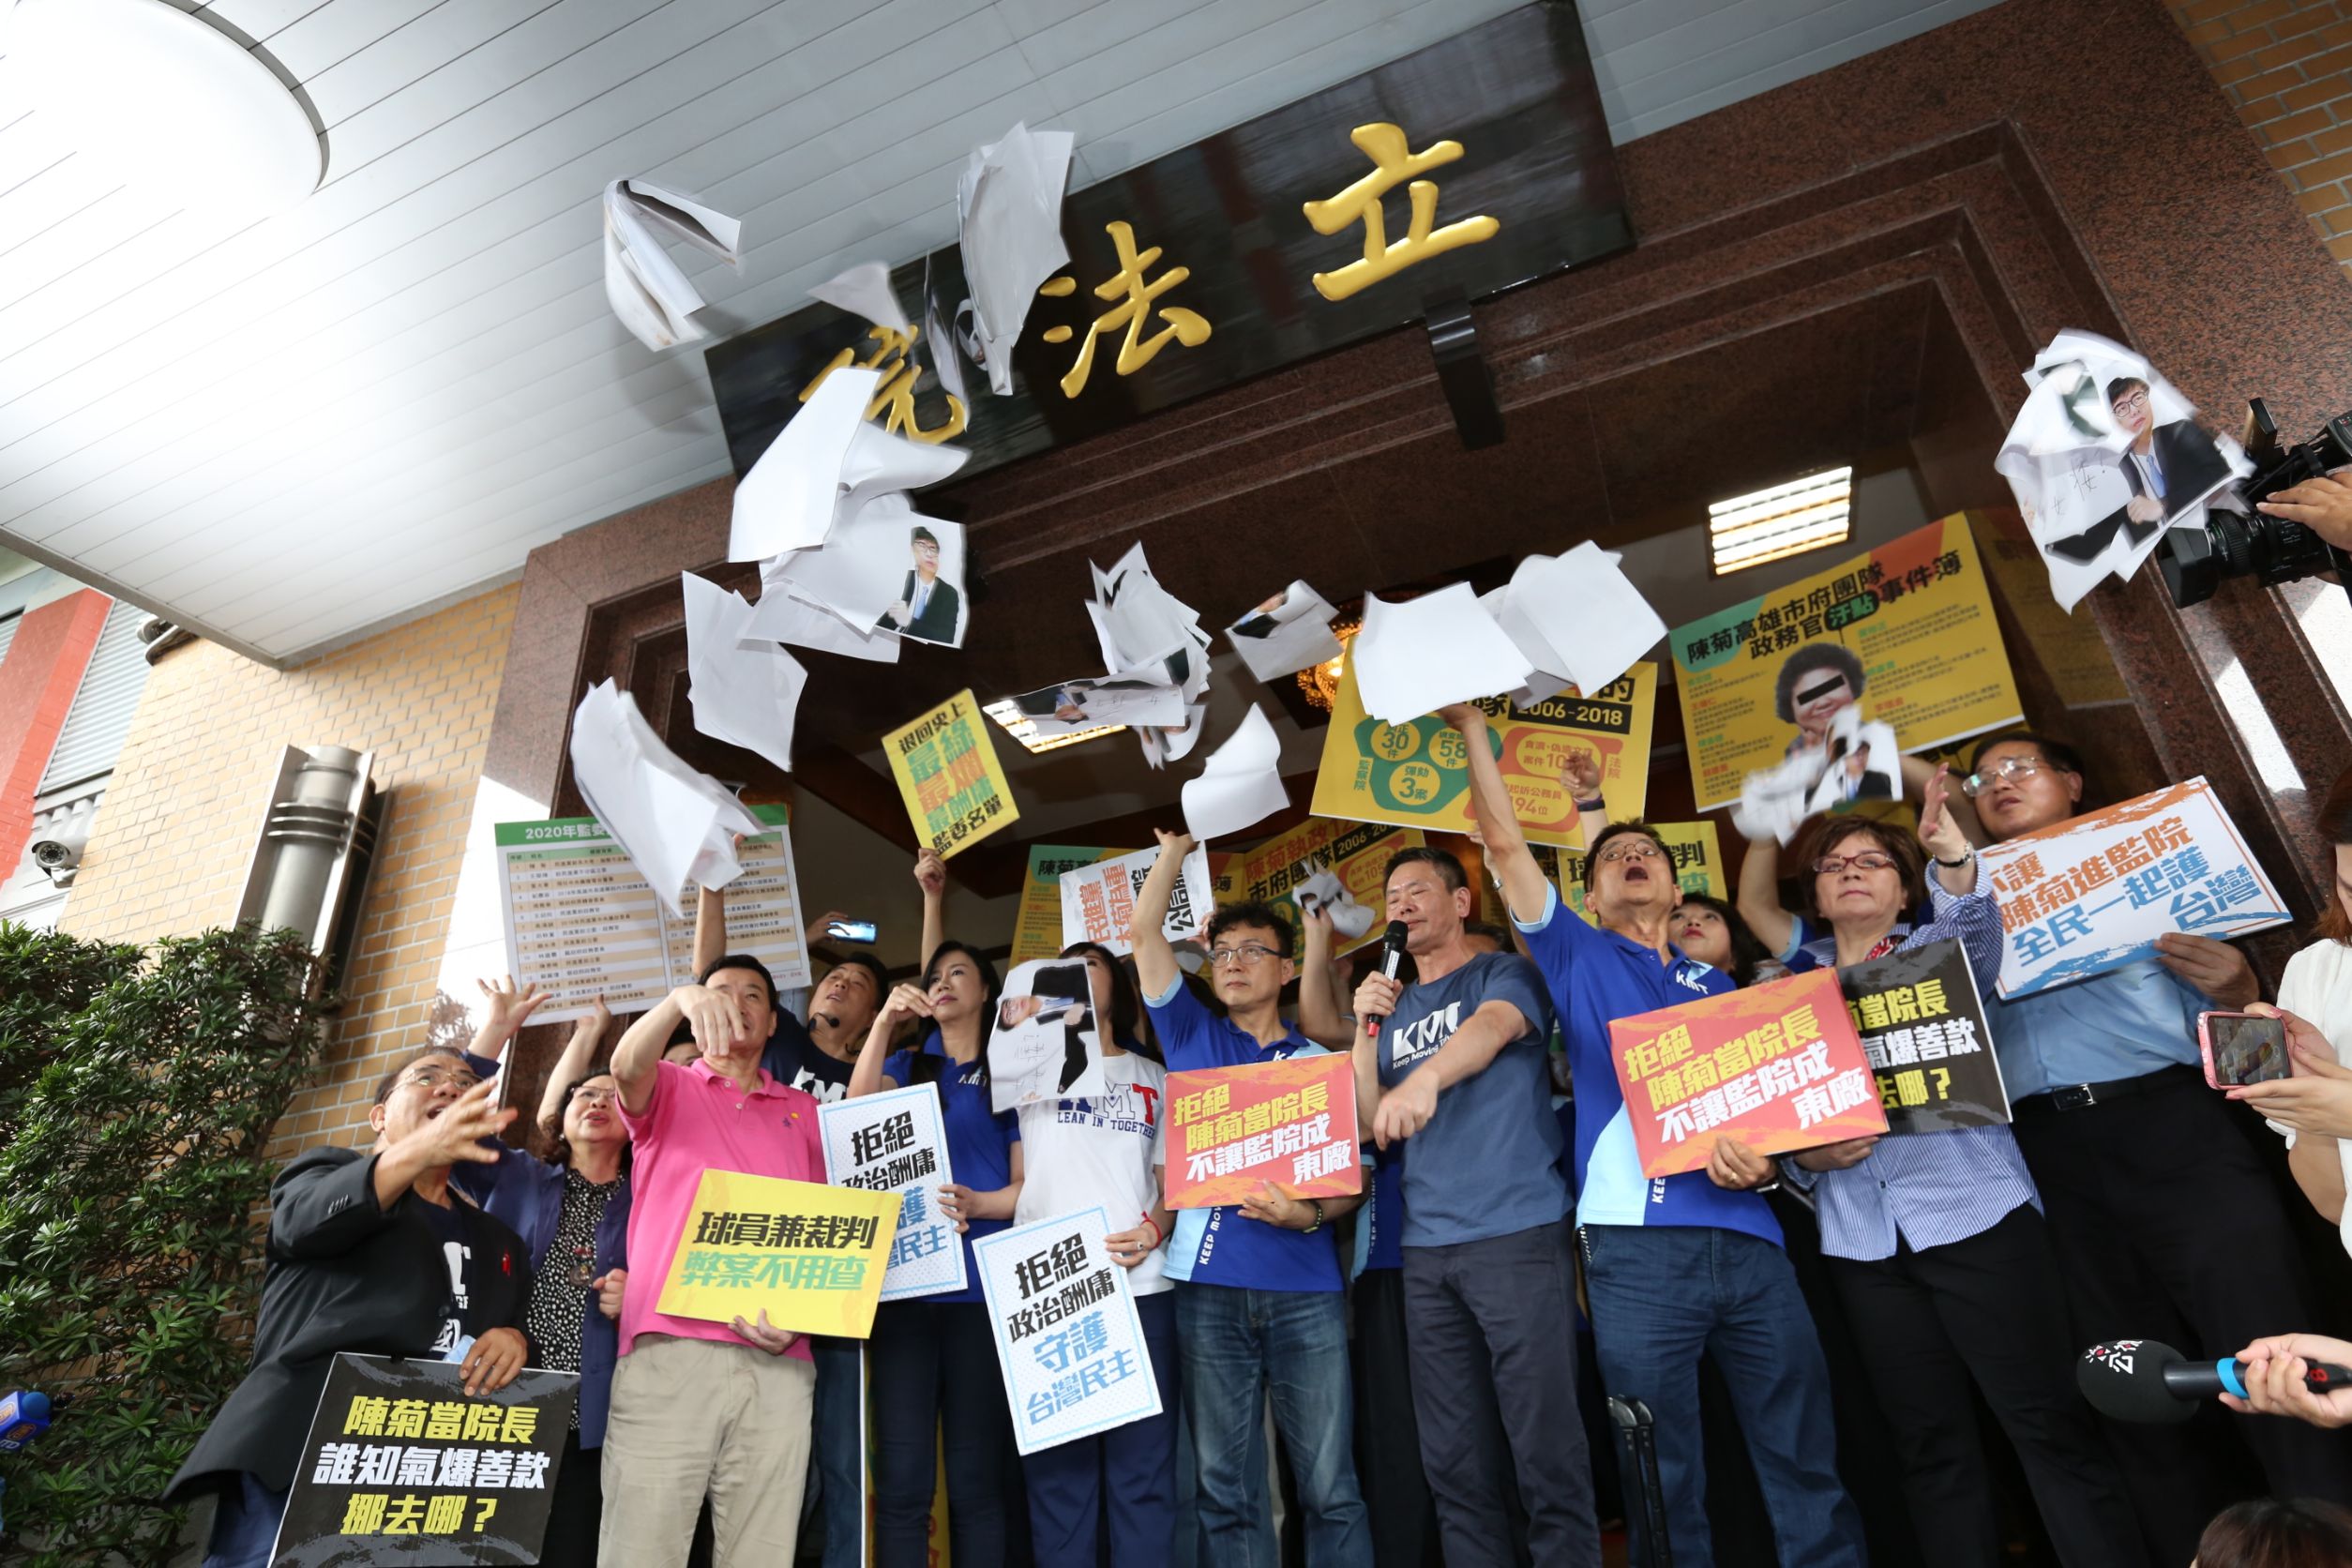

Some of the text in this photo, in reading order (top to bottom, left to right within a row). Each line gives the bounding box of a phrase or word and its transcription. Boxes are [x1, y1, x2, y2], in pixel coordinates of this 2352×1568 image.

[1687, 560, 1885, 663] 陳菊高雄市府團隊
[899, 701, 967, 756] 退回史上
[1380, 731, 1410, 751] 30
[1387, 748, 1400, 759] 件
[1440, 740, 1468, 760] 58
[1403, 764, 1430, 779] 彈劾
[1446, 758, 1458, 768] 件
[1606, 755, 1621, 780] 法院
[525, 824, 612, 840] 2020年監委
[931, 793, 1003, 855] 監委名單
[1512, 796, 1548, 817] 94位
[2001, 815, 2194, 935] 陳菊進監院
[2169, 864, 2262, 932] 台灣
[1079, 881, 1111, 944] 民進黨
[2013, 846, 2214, 968] 全民一起護
[1393, 1002, 1461, 1061] KMT
[1393, 1056, 1410, 1070] Keep
[1411, 1044, 1440, 1062] Moving
[1623, 1024, 1695, 1082] 拒絕
[1647, 1003, 1822, 1112] 陳菊當院長
[1058, 1111, 1086, 1124] LEAN
[1092, 1116, 1104, 1128] IN
[1174, 1083, 1230, 1127] 拒絕
[1186, 1081, 1330, 1154] 陳菊當院長
[1655, 1040, 1835, 1143] 不讓監院成
[1791, 1067, 1873, 1131] 東廠
[852, 1110, 916, 1167] 拒絕
[1186, 1112, 1332, 1184] 不讓監院成
[1292, 1138, 1352, 1186] 東廠
[692, 1211, 880, 1249] 球員兼裁判
[1199, 1234, 1214, 1265] KEEP
[679, 1251, 870, 1290] 弊案不用查
[1015, 1232, 1090, 1300] 拒絕
[1007, 1267, 1116, 1343] 政治酬庸
[1033, 1311, 1110, 1373] 守護
[1026, 1349, 1137, 1425] 台灣民主
[342, 1395, 540, 1444] 陳菊當院長
[311, 1442, 551, 1489] 誰知氣爆善款
